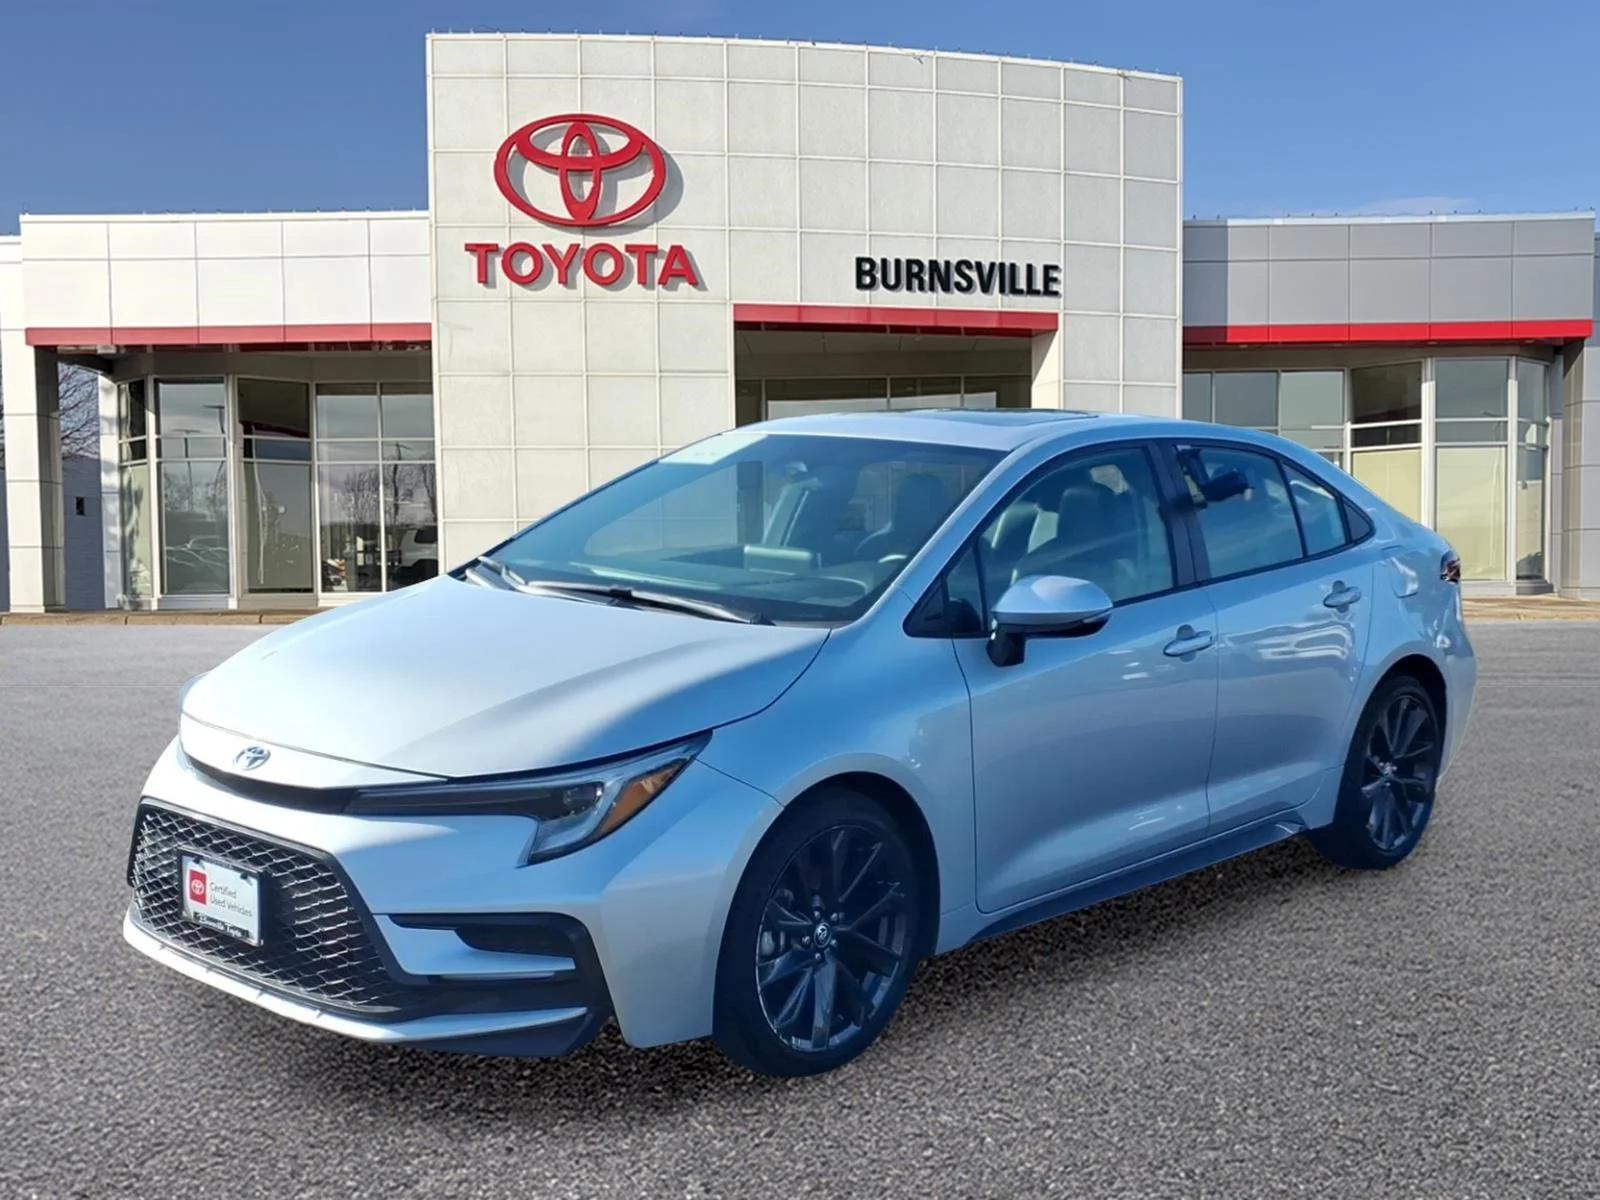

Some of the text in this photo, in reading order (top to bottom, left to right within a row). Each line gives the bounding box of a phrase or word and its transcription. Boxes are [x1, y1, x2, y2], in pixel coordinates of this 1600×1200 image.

[464, 241, 699, 287] TOYOTA
[855, 256, 1061, 297] BURNSVILLE
[209, 881, 238, 899] Certified
